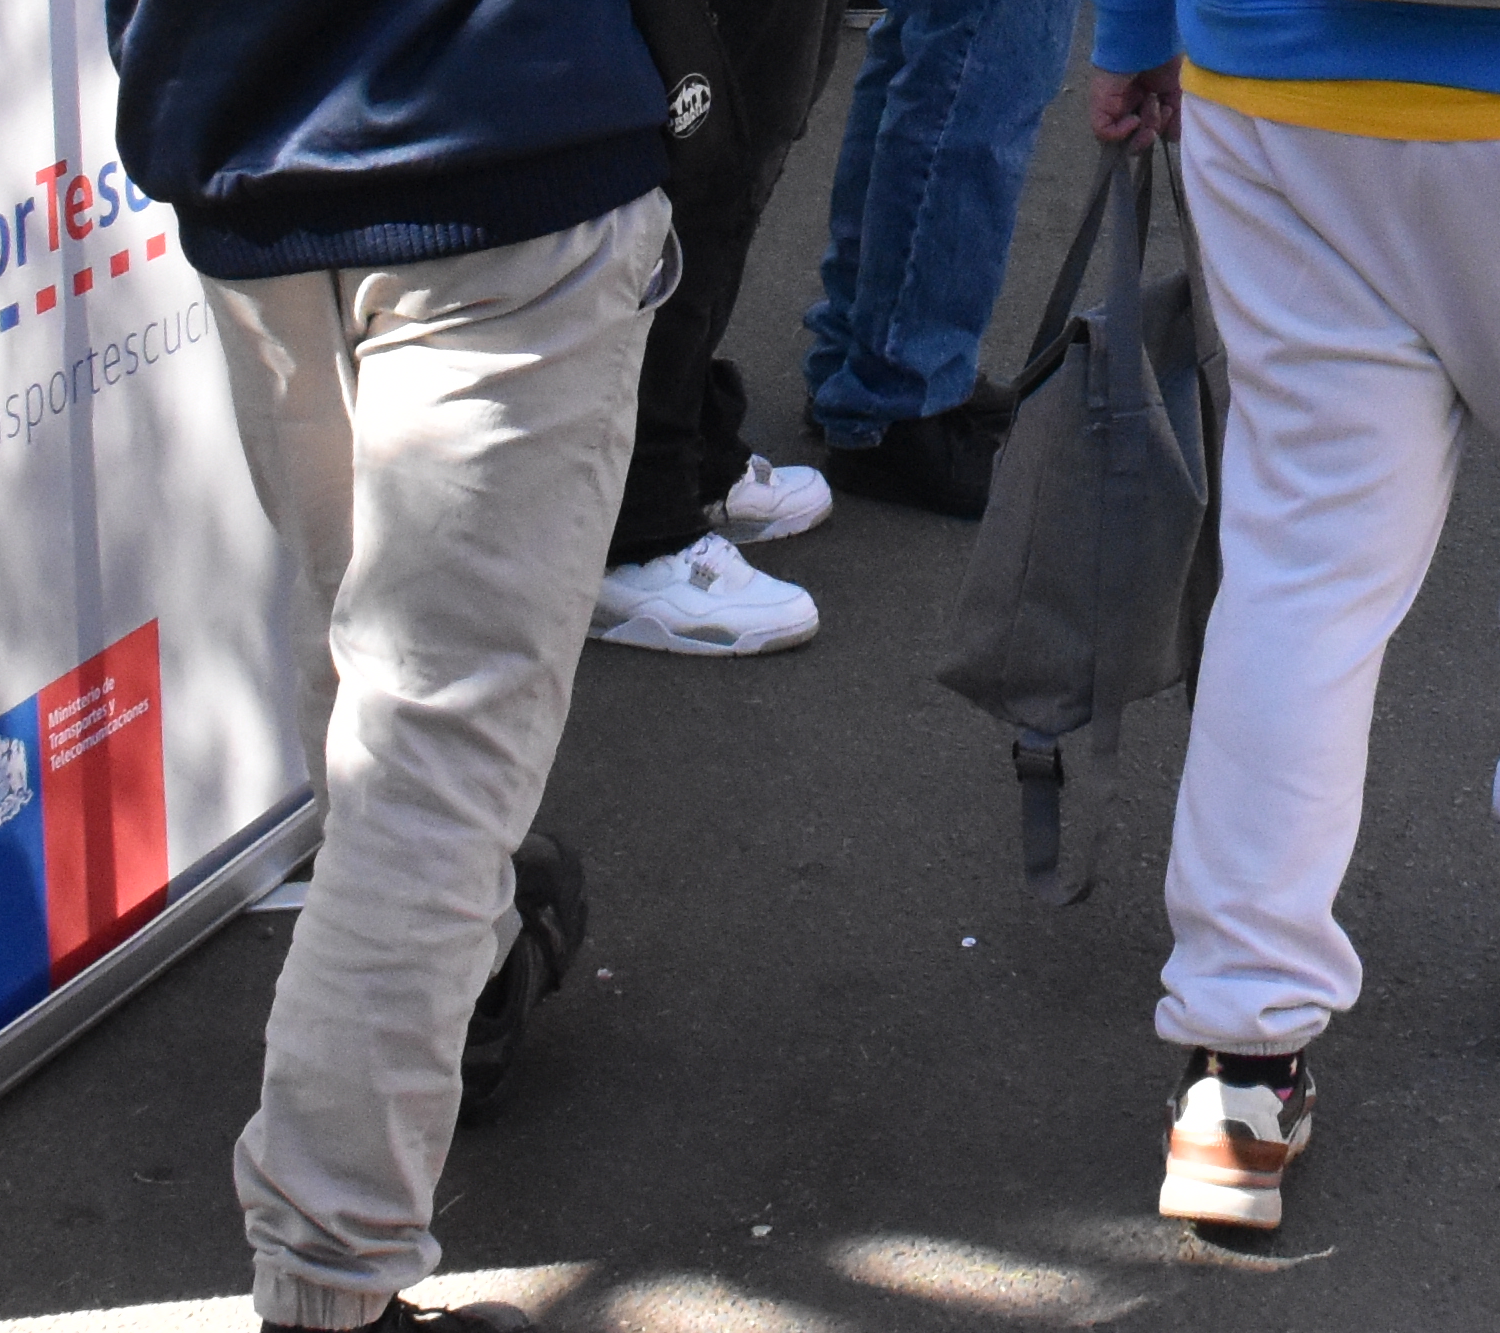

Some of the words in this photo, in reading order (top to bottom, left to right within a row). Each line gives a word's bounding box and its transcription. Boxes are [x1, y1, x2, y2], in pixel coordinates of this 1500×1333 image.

[48, 686, 101, 729] Ministerio
[103, 677, 115, 694] de
[49, 704, 107, 749] Transportes
[108, 698, 115, 716] y
[51, 698, 149, 771] Telecomunicaciones
